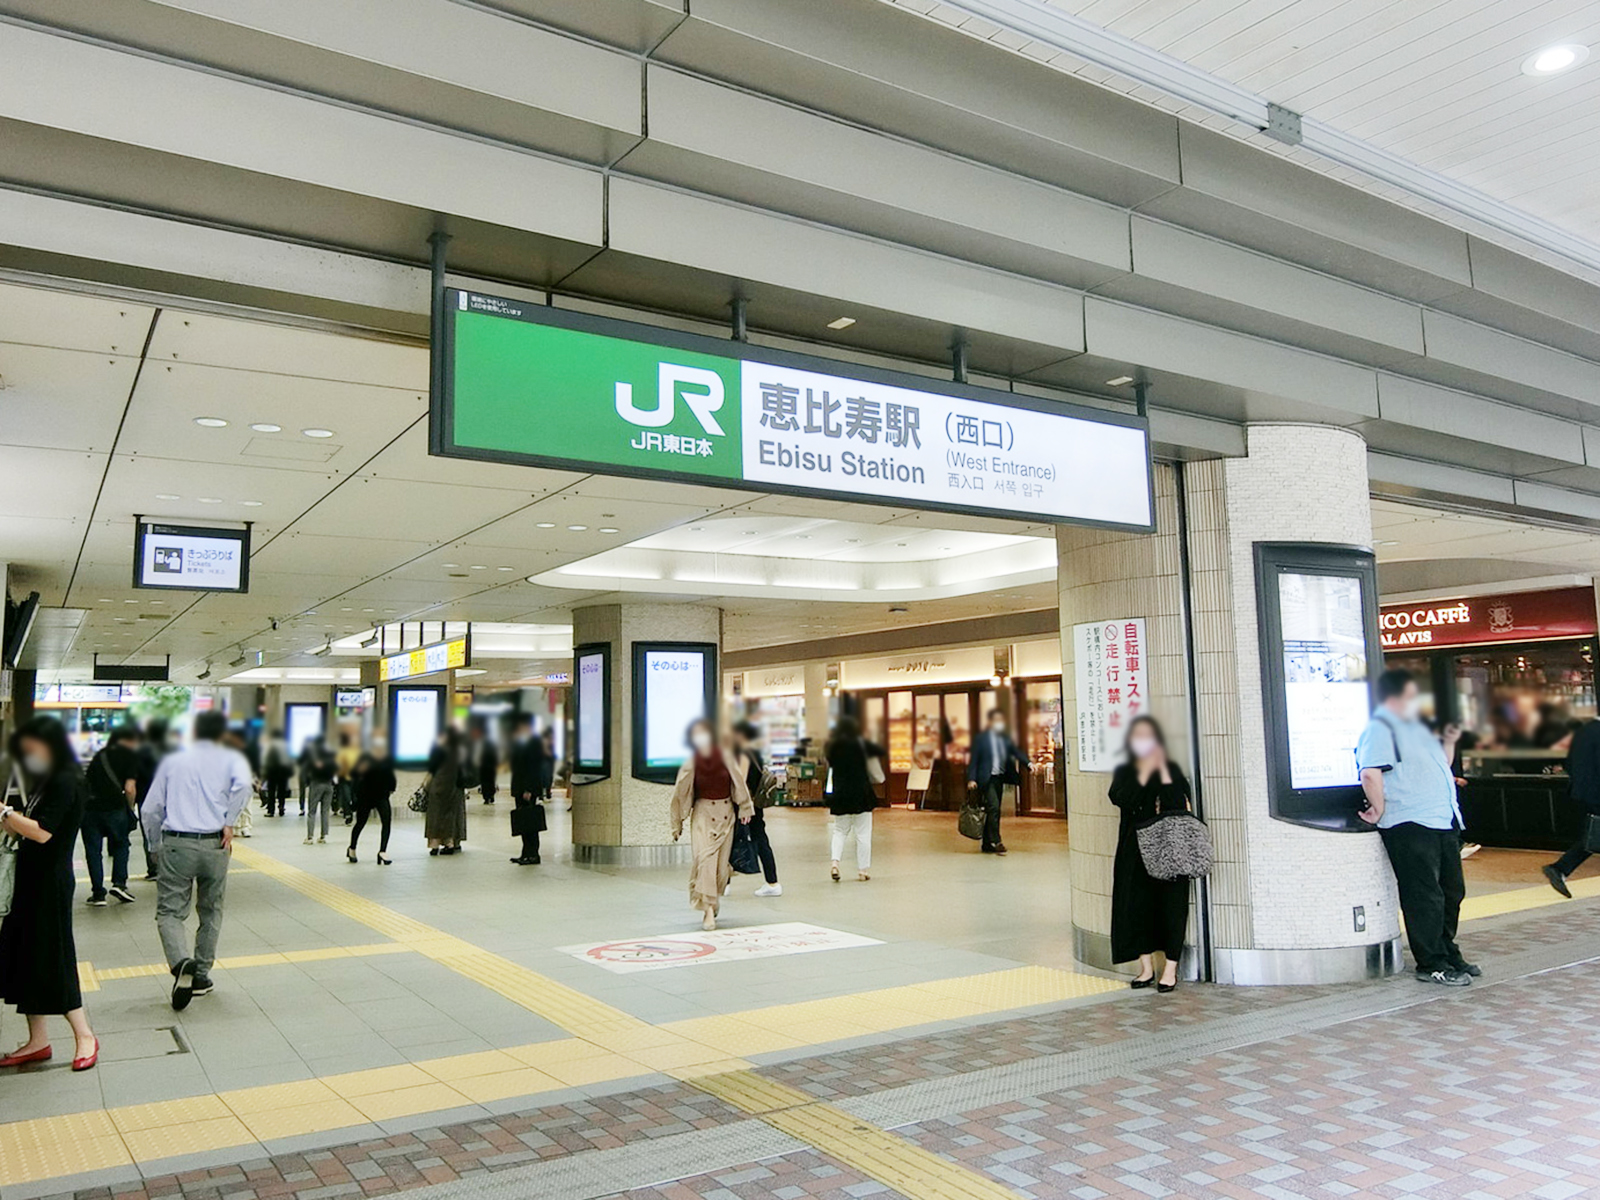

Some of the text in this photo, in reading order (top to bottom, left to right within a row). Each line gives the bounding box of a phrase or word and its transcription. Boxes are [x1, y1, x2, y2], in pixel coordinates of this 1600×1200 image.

[614, 362, 726, 437] JR
[759, 382, 922, 450] 恵比寿駅
[631, 431, 713, 458] JR東日本
[759, 439, 925, 484] Ebisu Station
[946, 449, 1056, 482] (West Entrance)
[948, 472, 984, 491] 西入口
[187, 549, 233, 561] きっぷうりば
[1412, 603, 1470, 627] CAFFÈ
[1398, 630, 1432, 645] AVIS
